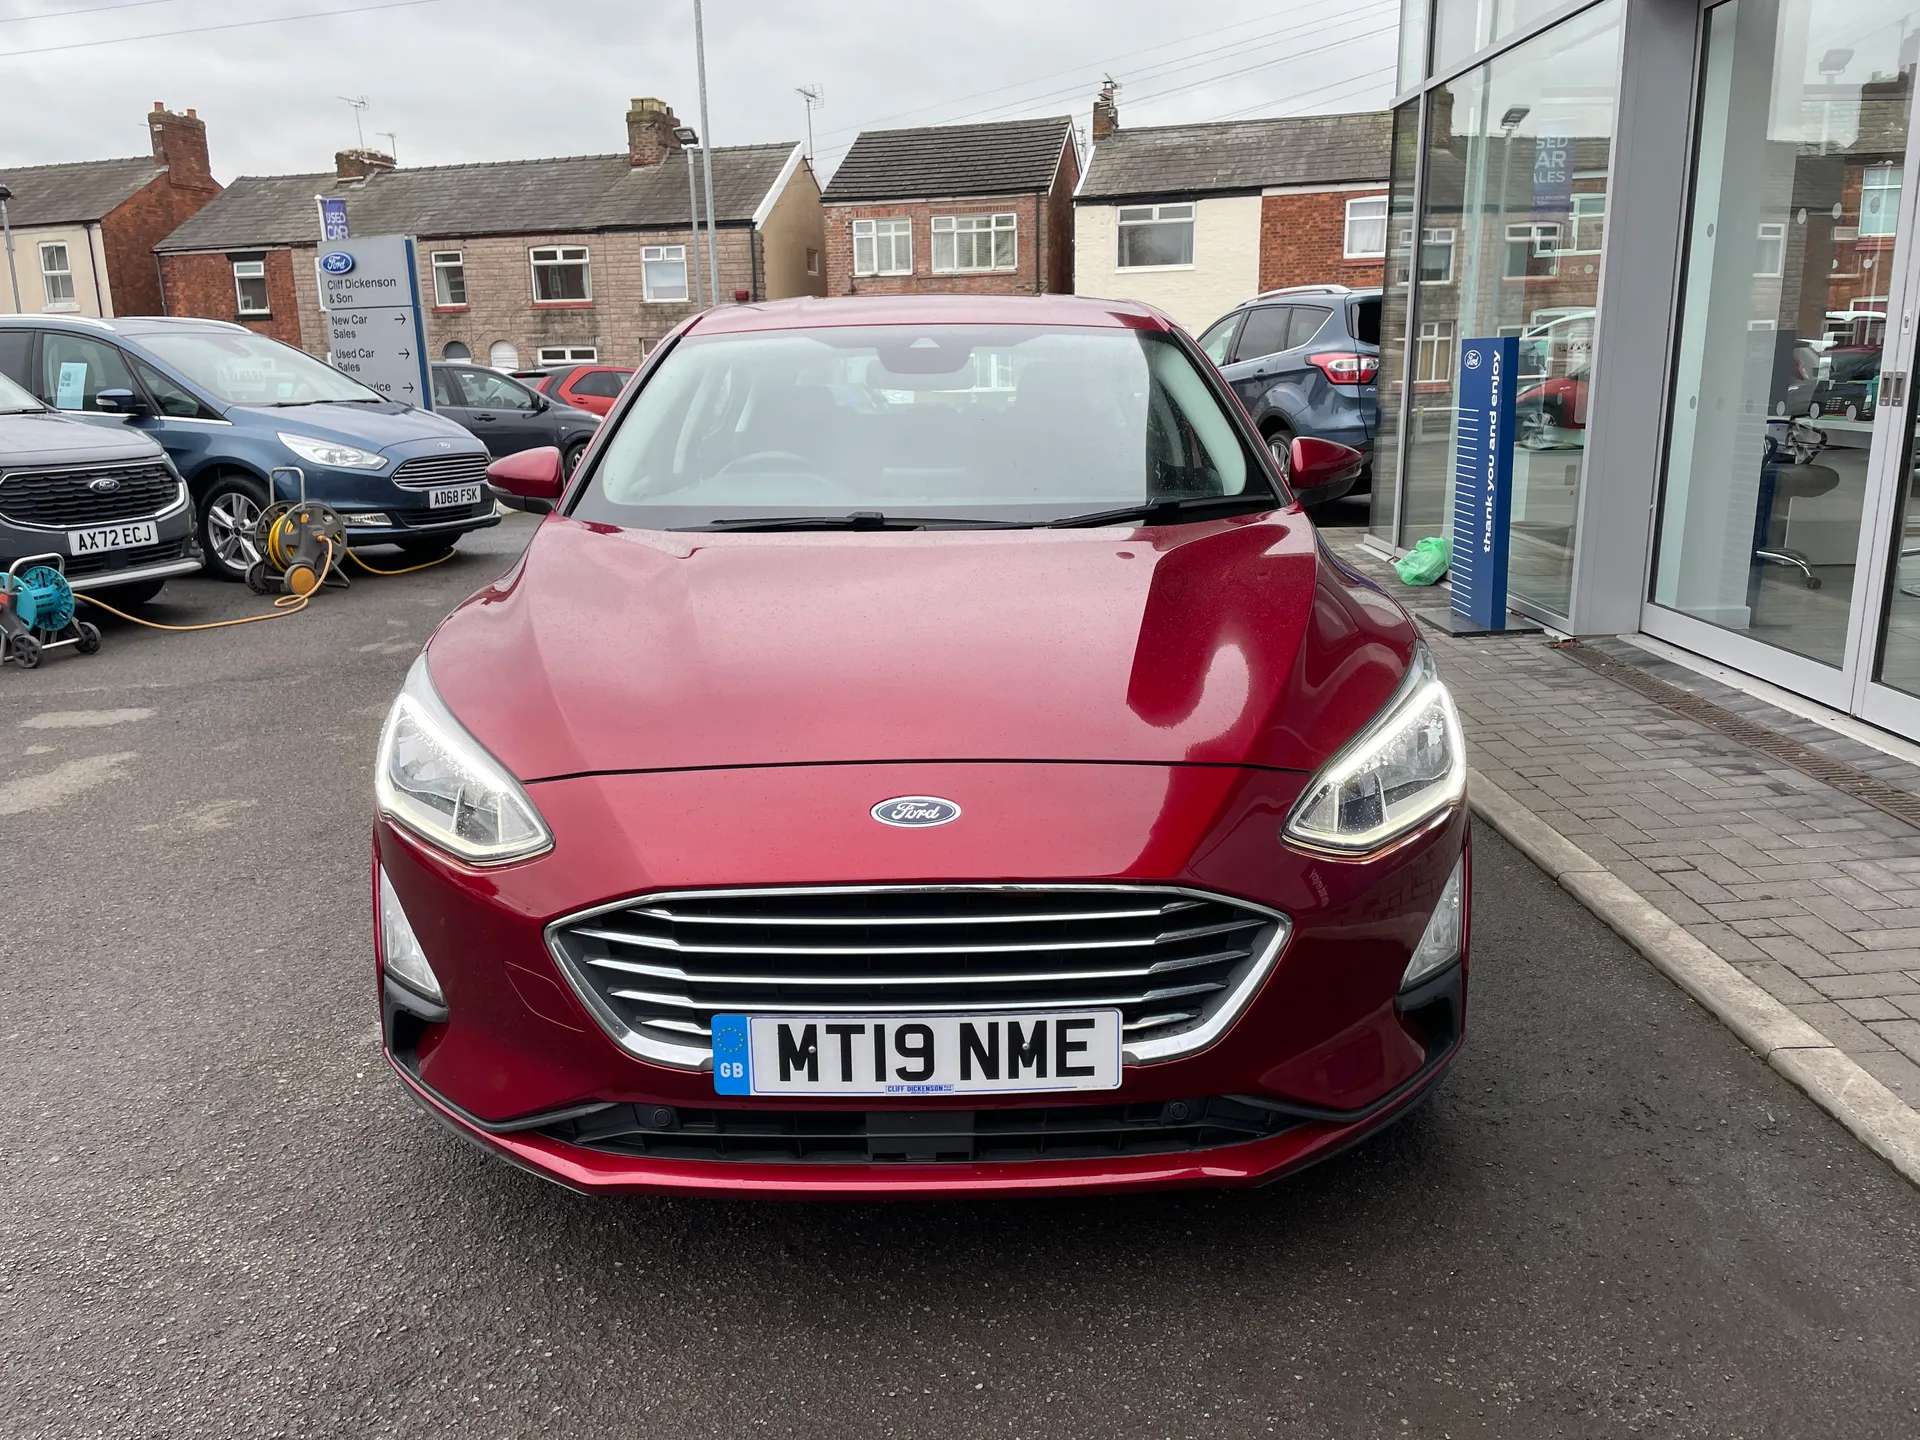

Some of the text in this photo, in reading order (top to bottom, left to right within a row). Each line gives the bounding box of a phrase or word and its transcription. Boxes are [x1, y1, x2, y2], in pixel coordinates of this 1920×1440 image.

[1535, 136, 1568, 149] SED
[1534, 151, 1567, 169] AR
[1533, 171, 1566, 183] LES
[326, 212, 346, 223] USED
[327, 225, 350, 240] CAR
[328, 277, 397, 290] Cliff Dickenson
[329, 293, 353, 304] & Son
[332, 314, 368, 326] New Car
[333, 328, 356, 339] Sales
[336, 348, 375, 359] Used Car
[337, 361, 360, 372] Sales
[1484, 350, 1501, 553] thank you and enjoy
[434, 487, 478, 506] AD68 FSK
[79, 524, 152, 551] AX72 ECJ
[891, 802, 941, 820] Ford
[777, 1018, 1096, 1083] MT19 NME
[720, 1062, 744, 1078] GB
[887, 1085, 905, 1093] CLIFF
[907, 1084, 944, 1093] DICKENSON
